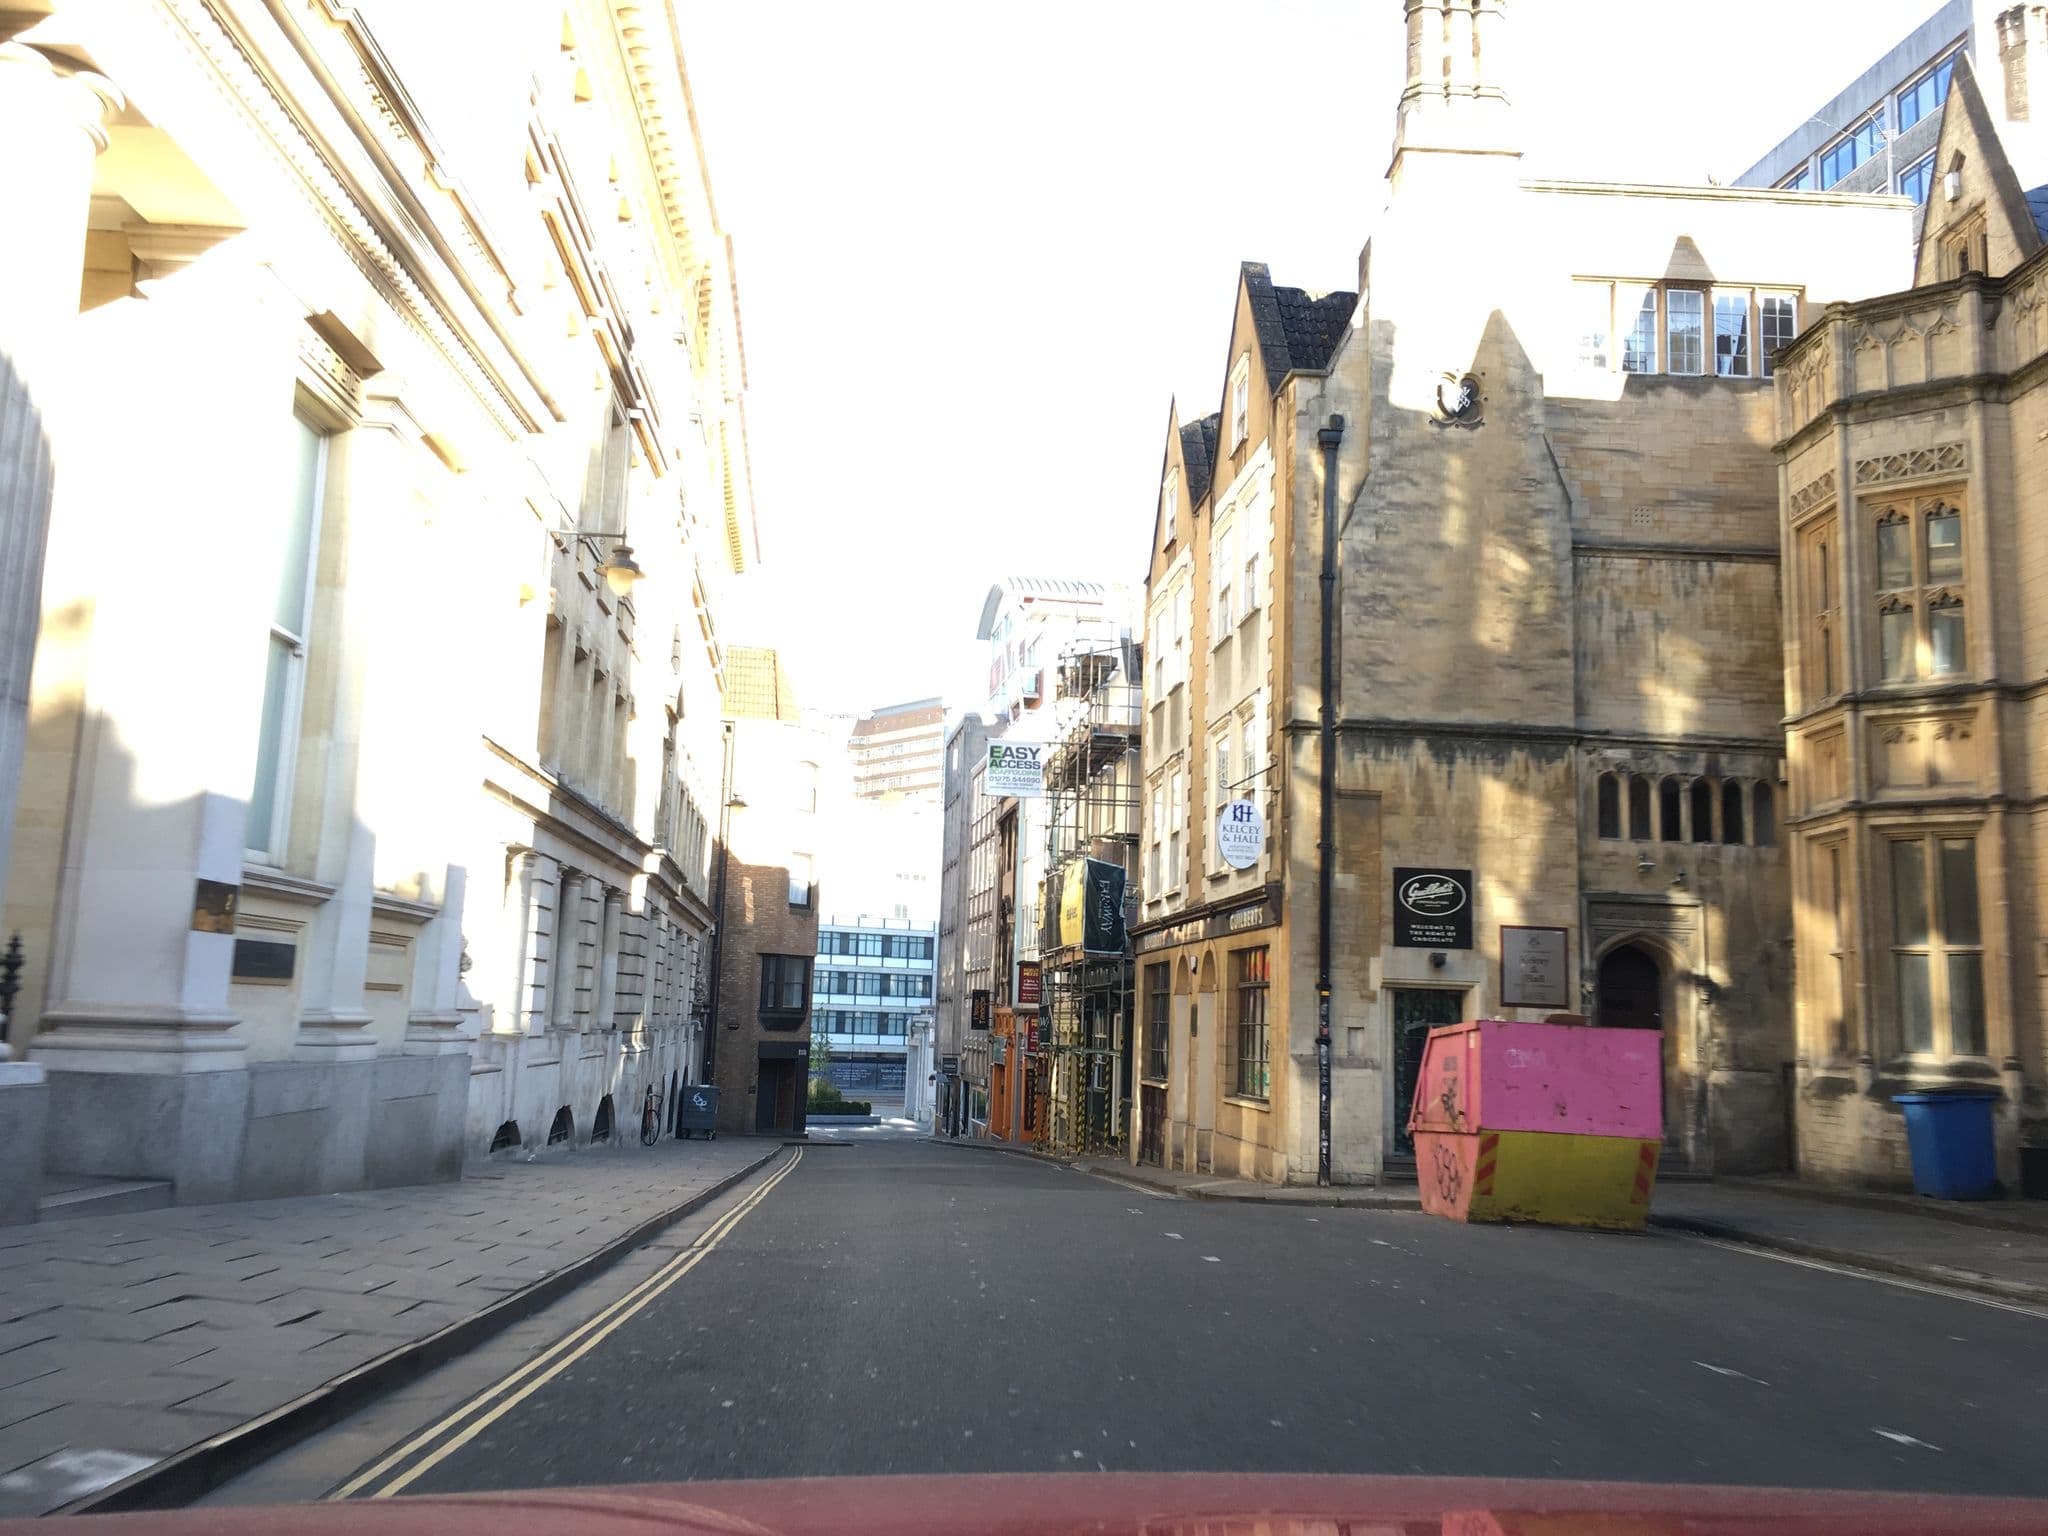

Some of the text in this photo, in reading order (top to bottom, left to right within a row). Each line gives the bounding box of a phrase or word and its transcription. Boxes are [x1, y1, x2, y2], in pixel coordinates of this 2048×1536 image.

[990, 745, 1041, 760] EASY
[989, 759, 1041, 769] ACCESS
[1222, 824, 1261, 834] KELCEY
[1222, 833, 1260, 844] & HALL
